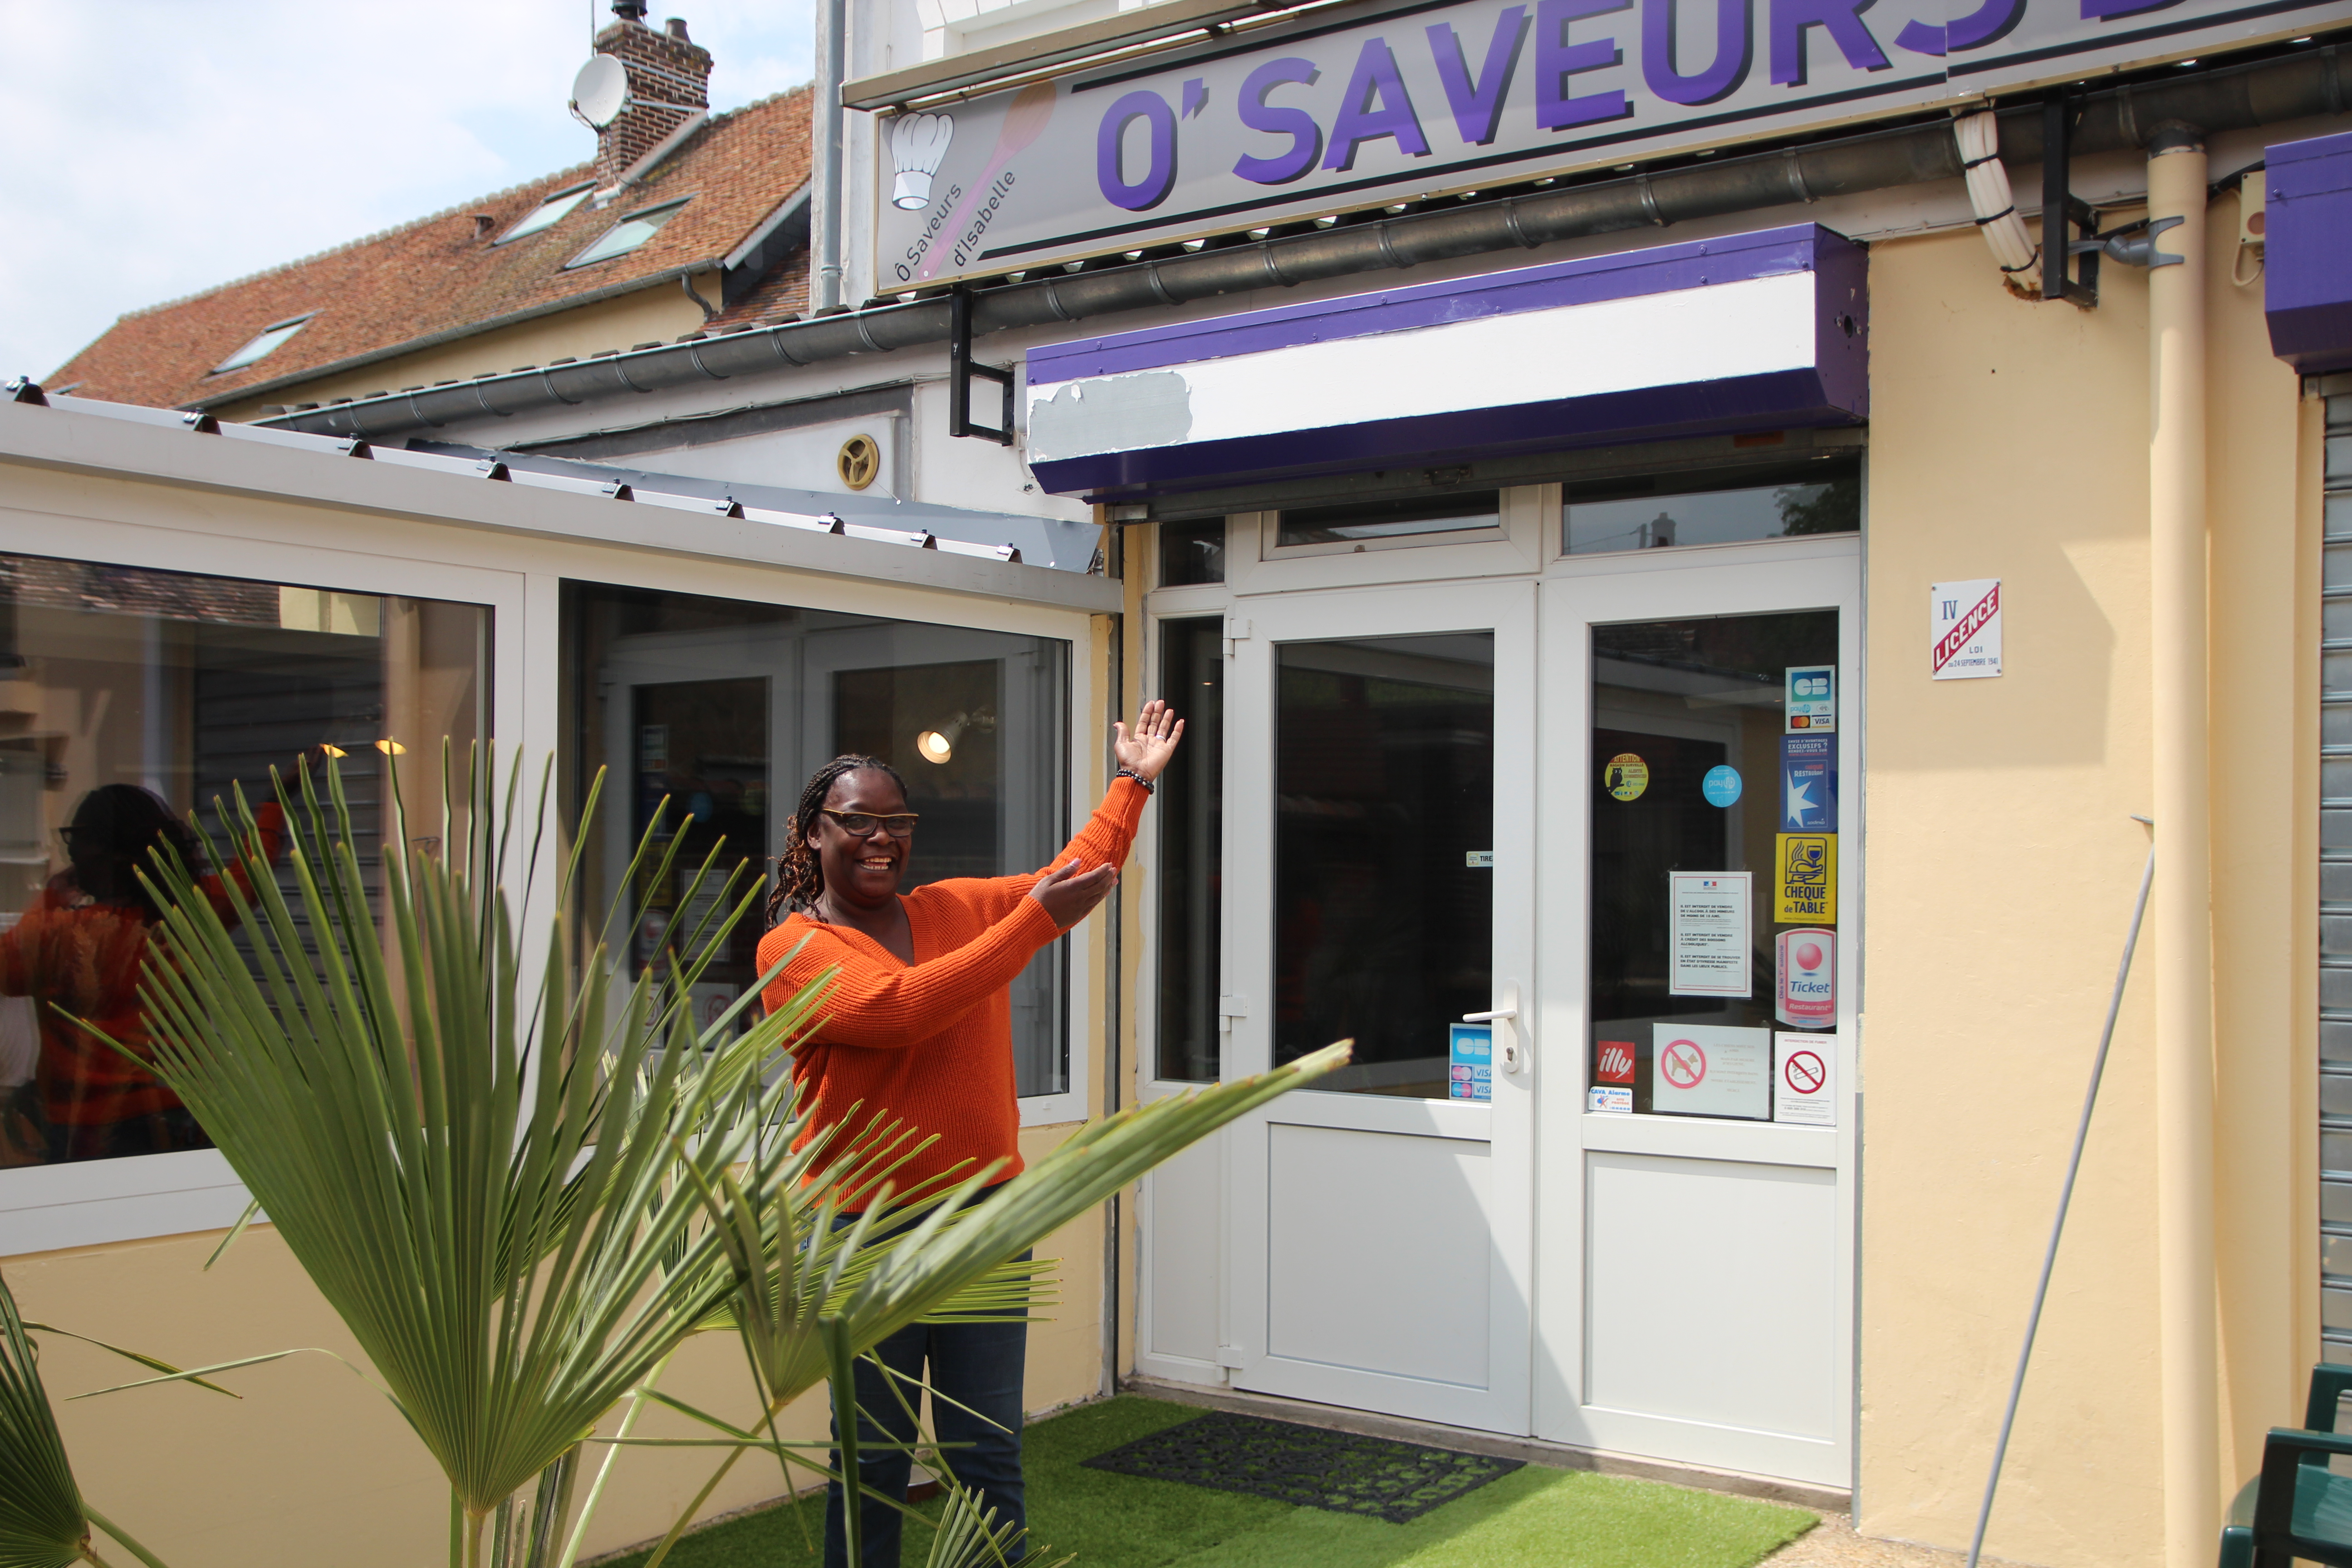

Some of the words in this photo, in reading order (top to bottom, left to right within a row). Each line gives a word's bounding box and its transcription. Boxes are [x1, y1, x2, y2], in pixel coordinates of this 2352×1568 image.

[907, 184, 961, 266] Saveurs
[954, 171, 1015, 267] d'Isabelle
[1941, 600, 1958, 620] IV
[1936, 590, 1996, 667] LICENCE
[1961, 658, 1986, 666] SEPTEMBRE
[1614, 754, 1640, 762] ATTENTION
[1785, 886, 1826, 901] CHEQUE
[1790, 981, 1830, 993] Ticket
[1599, 1047, 1632, 1079] illy
